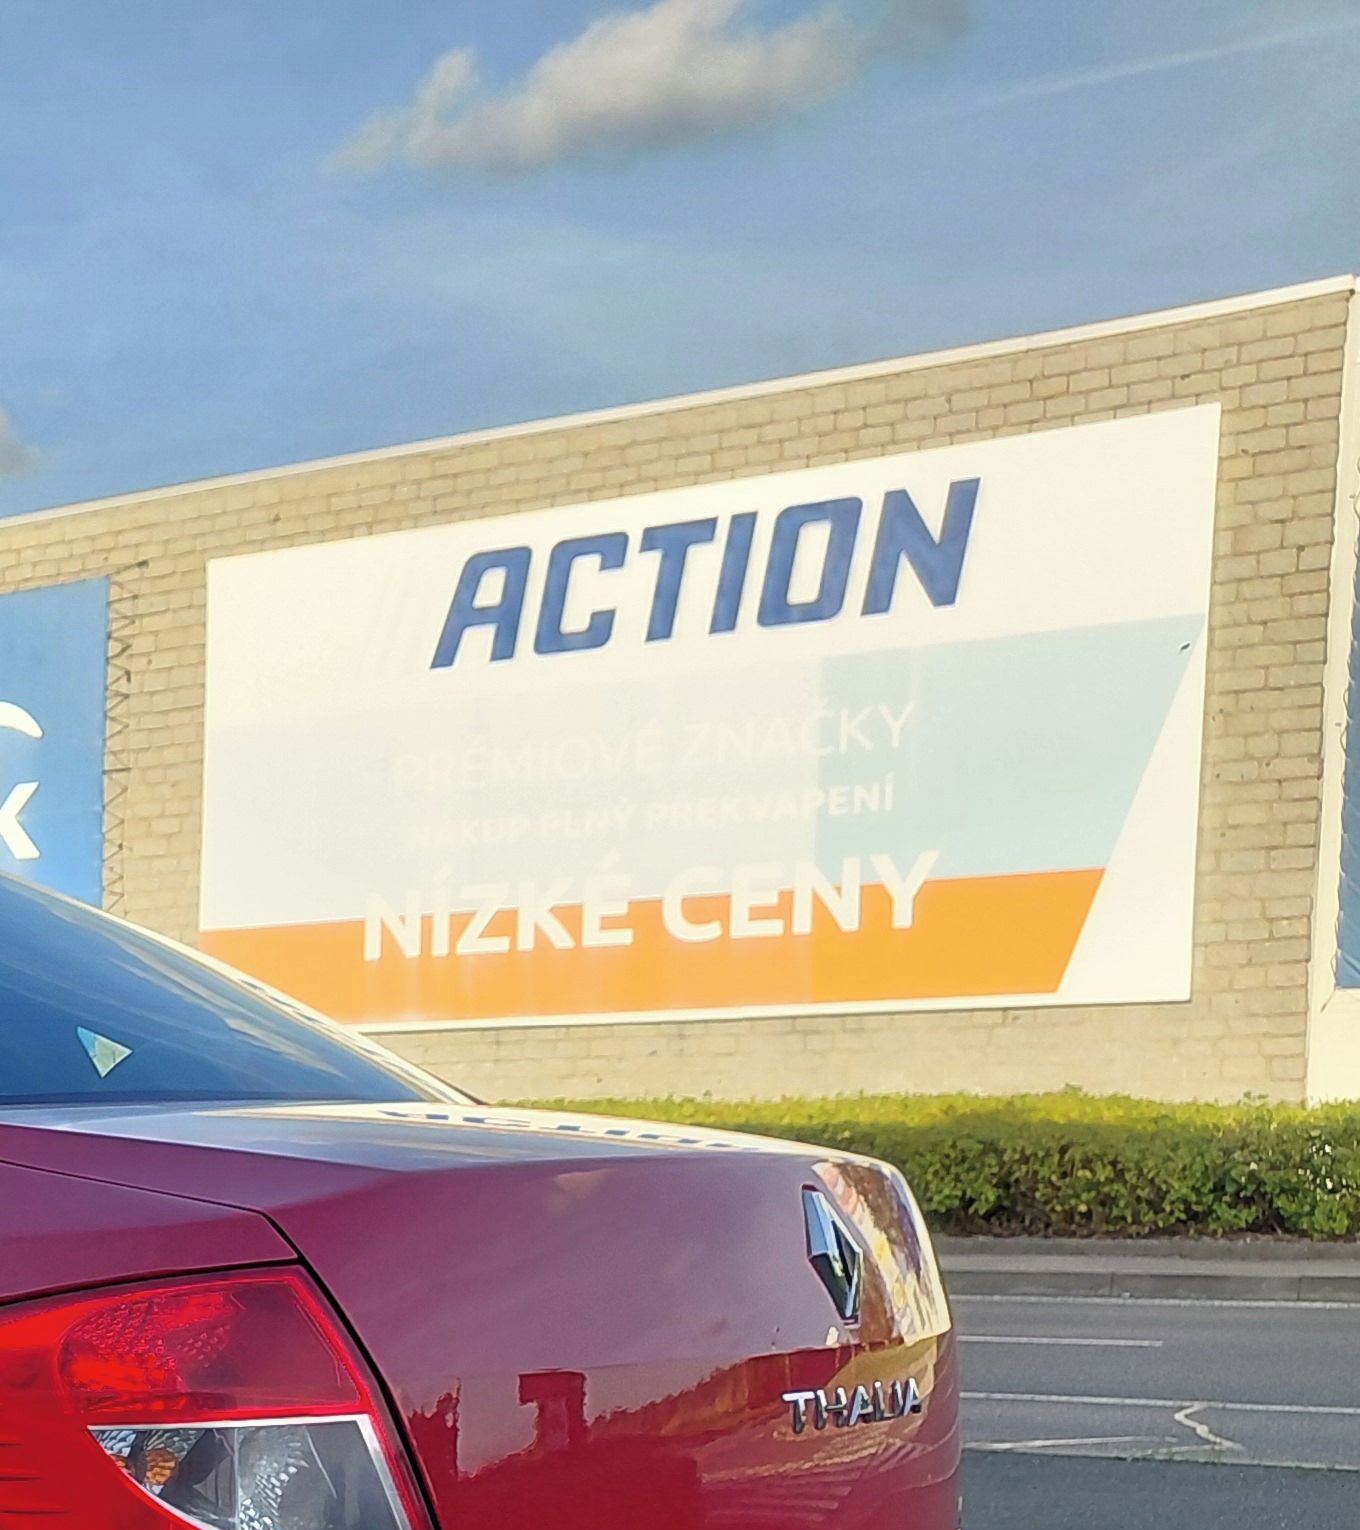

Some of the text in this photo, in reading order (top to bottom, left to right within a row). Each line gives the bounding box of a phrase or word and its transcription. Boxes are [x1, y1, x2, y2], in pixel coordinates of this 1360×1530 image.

[429, 477, 981, 668] ACTION
[679, 699, 917, 767] ZNAČKY
[647, 771, 896, 830] PŘEKVAPENÍ
[363, 851, 940, 961] NÍZKÉ CENY
[782, 1378, 922, 1434] THALIA
